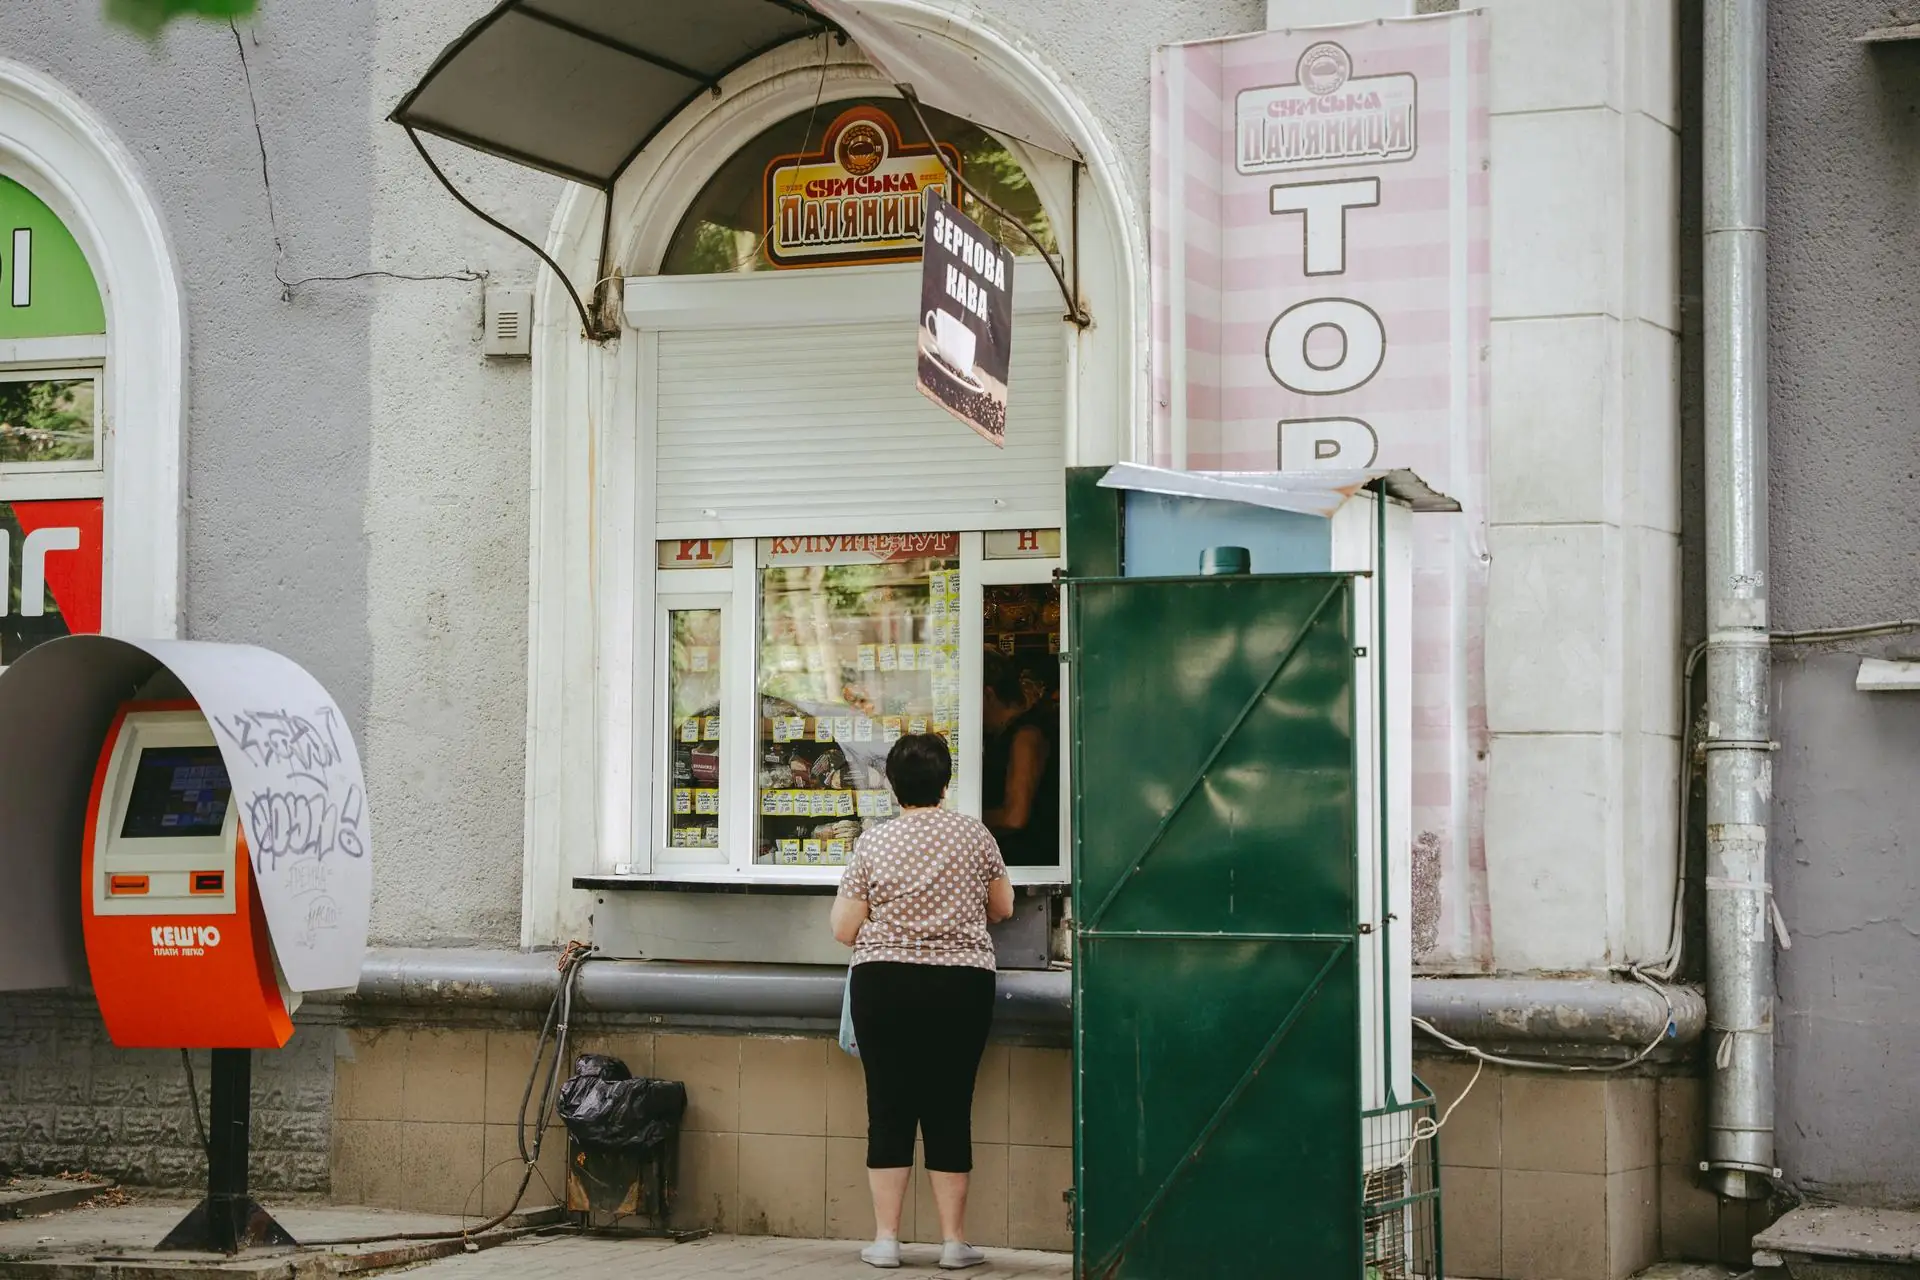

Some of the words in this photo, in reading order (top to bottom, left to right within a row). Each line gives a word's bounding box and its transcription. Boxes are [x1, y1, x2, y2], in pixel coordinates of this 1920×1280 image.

[1242, 104, 1411, 163] ПАЛЯНИЦЯ
[780, 183, 946, 246] ПАЛЯНИЦ
[805, 172, 918, 199] СУМСЬКА
[933, 210, 1005, 292] ЗЕРНОВА
[945, 263, 988, 322] КАВА
[151, 925, 221, 948] КЕШ'Ю
[153, 948, 179, 957] ПЛАТИ
[182, 948, 205, 957] ЛЕГКО
